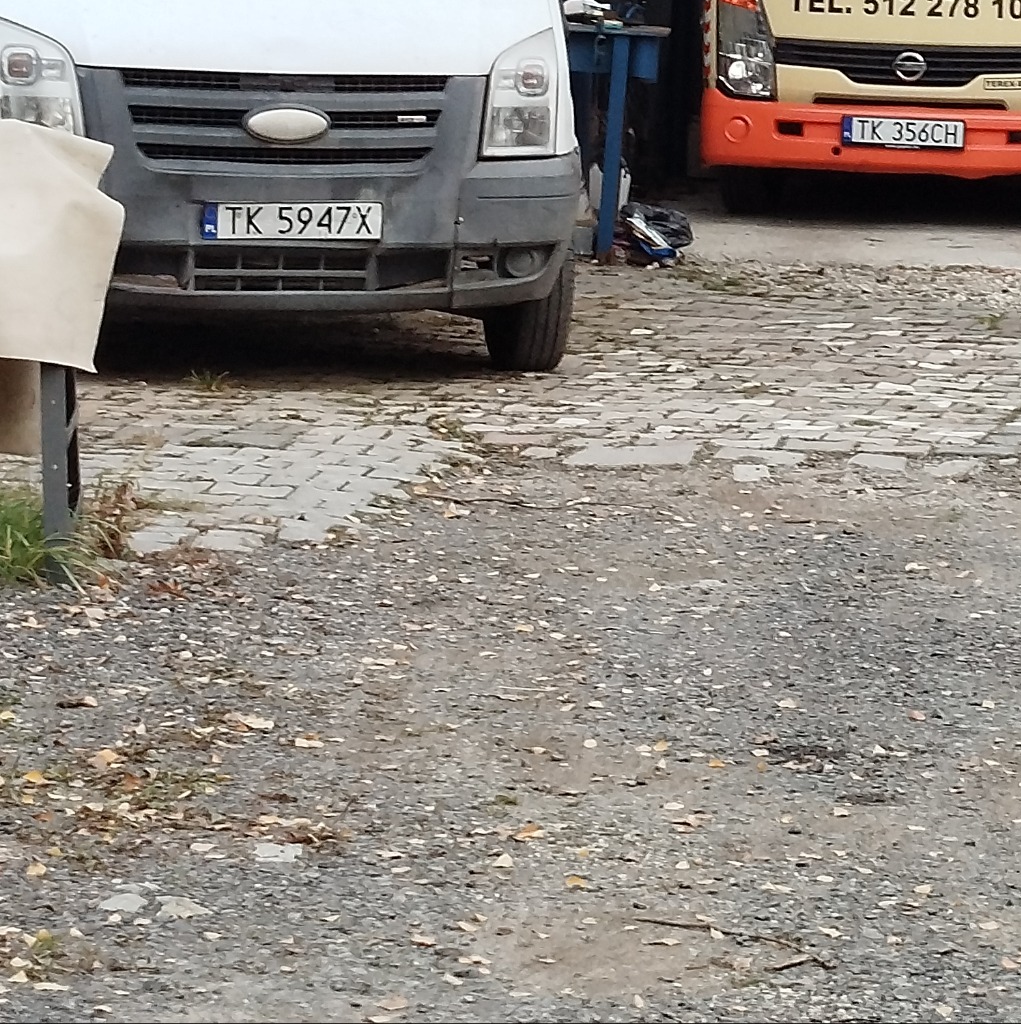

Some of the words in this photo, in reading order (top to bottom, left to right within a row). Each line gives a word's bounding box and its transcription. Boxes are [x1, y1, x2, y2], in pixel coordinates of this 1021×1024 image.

[857, 119, 883, 141] TK
[892, 121, 958, 144] 356CH
[225, 206, 263, 235] TK
[277, 206, 373, 235] 5947X
